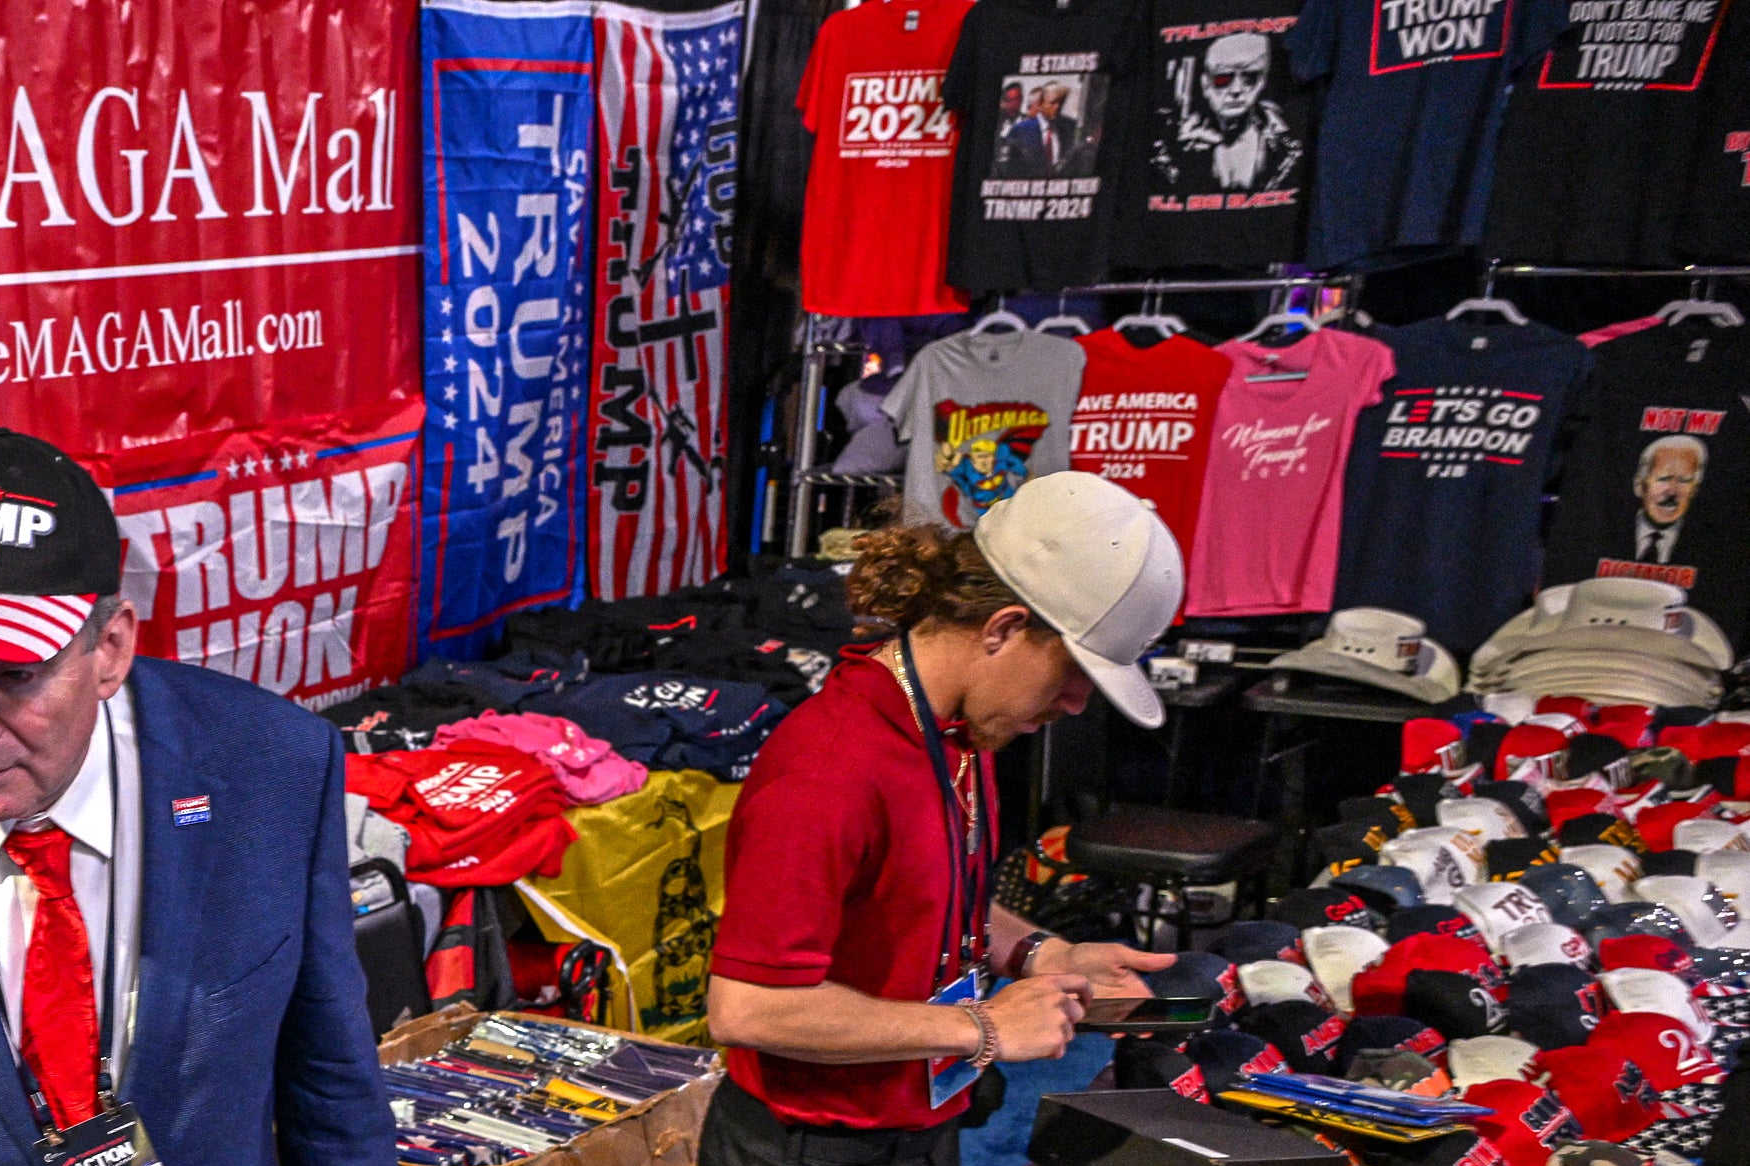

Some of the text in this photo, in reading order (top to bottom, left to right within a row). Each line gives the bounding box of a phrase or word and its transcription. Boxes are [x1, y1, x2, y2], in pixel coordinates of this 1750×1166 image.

[1398, 16, 1488, 59] WON
[1593, 21, 1650, 42] VOTED
[1649, 21, 1688, 42] FOR
[1576, 43, 1681, 79] TRUMP
[846, 104, 951, 141] 2024
[240, 87, 396, 217] Mall
[984, 197, 1094, 220] TRUMP 2024
[496, 94, 564, 584] TRUMP
[592, 146, 653, 513] TRUMP
[457, 211, 503, 494] 2024
[1076, 391, 1199, 411] AVE AMERICA
[1386, 399, 1541, 429] LET'S GO
[1070, 421, 1195, 451] TRUMP
[1381, 426, 1533, 454] BRANDON
[1099, 463, 1146, 479] 2024
[117, 461, 409, 621] TRUMP
